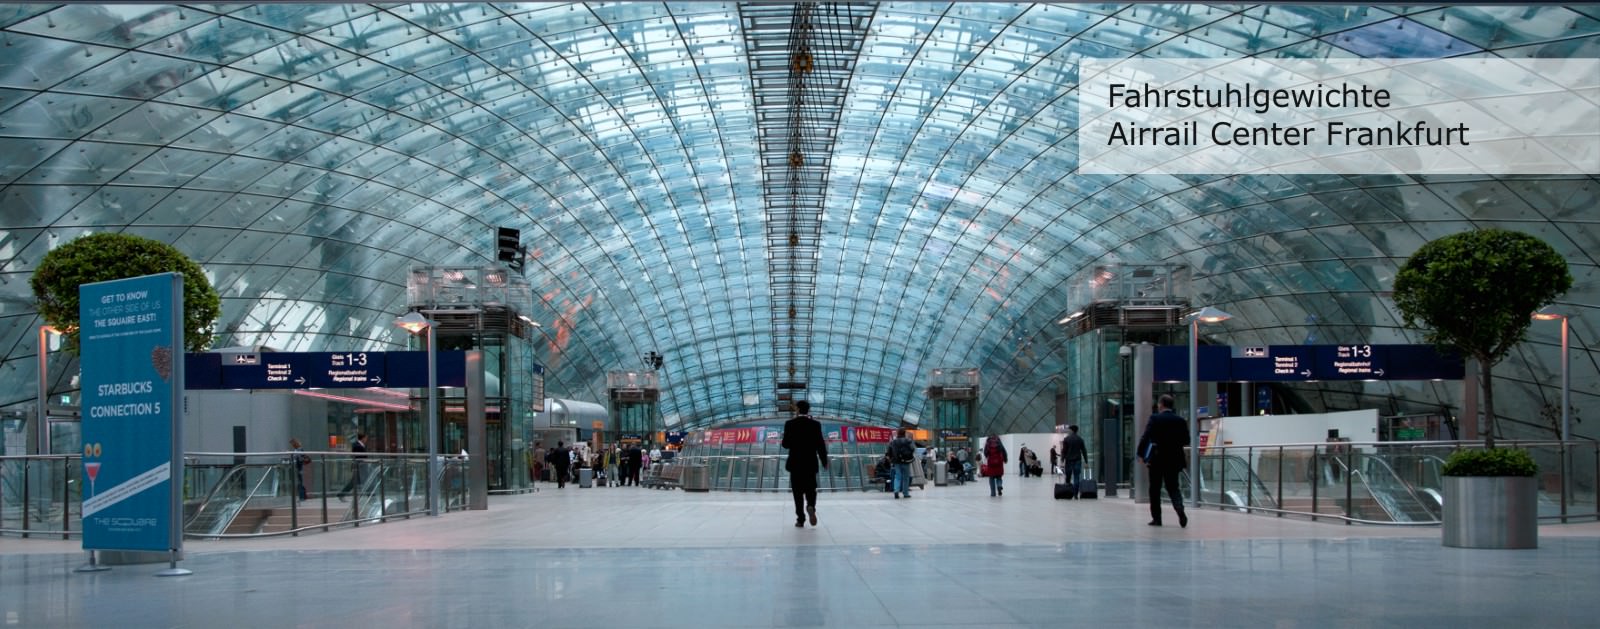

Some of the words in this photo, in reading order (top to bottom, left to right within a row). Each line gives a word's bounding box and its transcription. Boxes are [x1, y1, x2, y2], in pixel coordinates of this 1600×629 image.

[101, 295, 114, 304] GET
[116, 293, 126, 302] TO
[127, 290, 148, 301] KNOW
[125, 302, 139, 313] SIDE
[151, 300, 161, 310] US
[94, 319, 107, 328] THE
[107, 315, 136, 327] SQUAIRE
[1351, 345, 1371, 358] 1-3
[346, 353, 367, 366] 1-3
[98, 381, 153, 397] STARBUCKS
[90, 403, 152, 418] CONNECTION
[154, 402, 161, 414] 5
